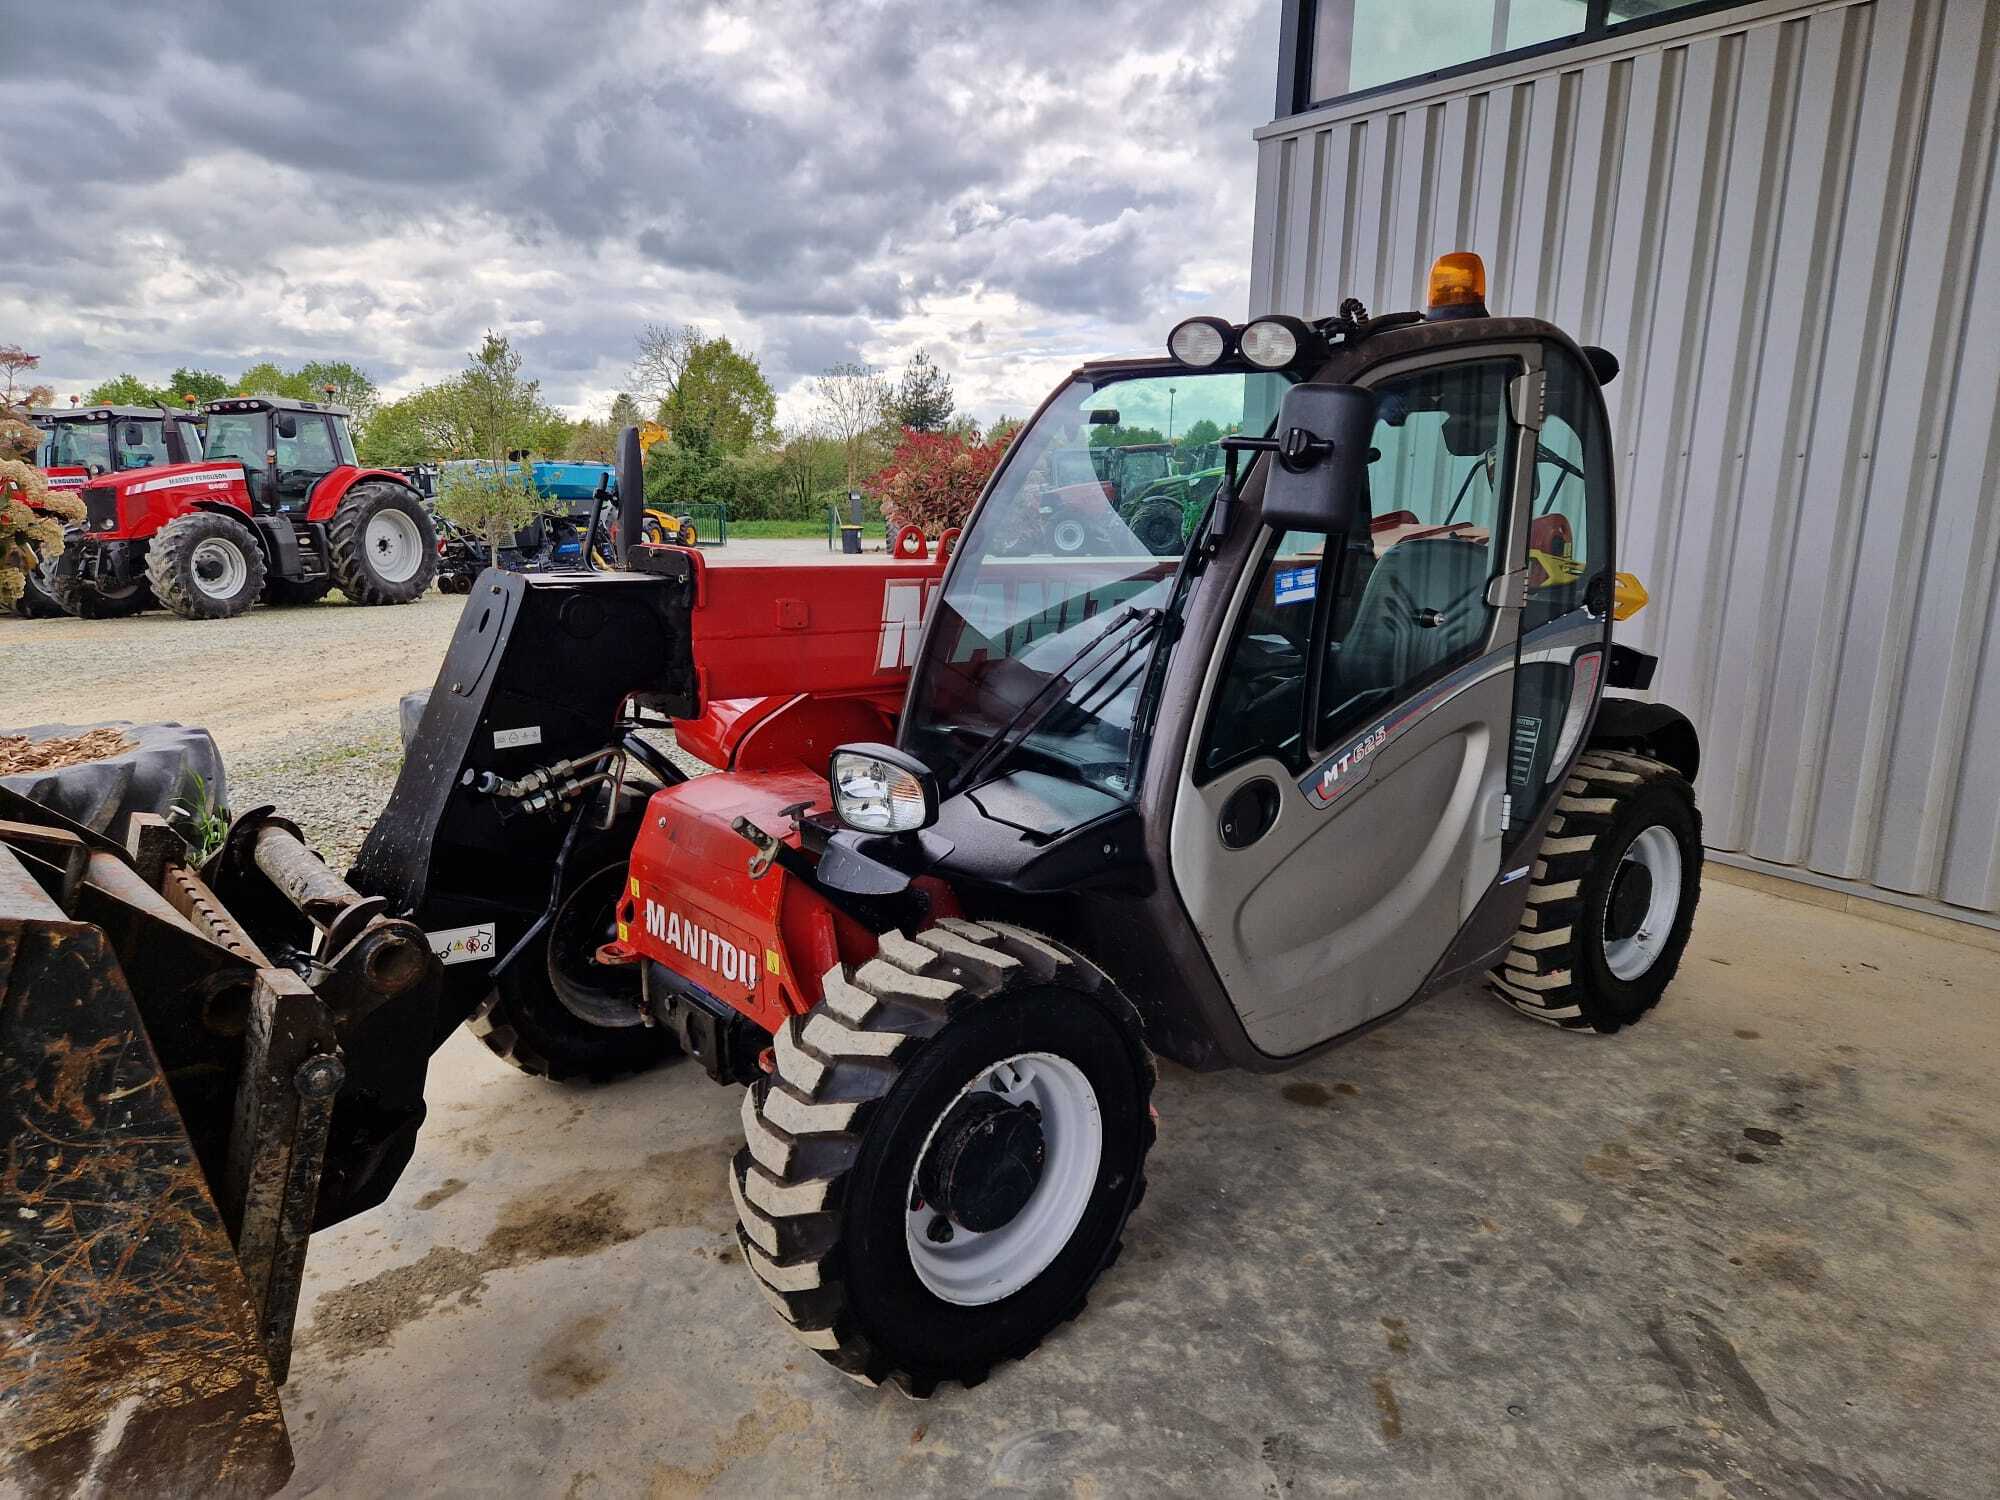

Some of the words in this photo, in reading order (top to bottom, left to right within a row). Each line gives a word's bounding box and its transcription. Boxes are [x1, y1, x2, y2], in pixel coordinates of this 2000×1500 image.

[168, 475, 194, 486] MASSEY
[195, 472, 228, 482] FERGUSON
[1323, 753, 1352, 788] MT
[1353, 725, 1386, 764] 625
[646, 899, 757, 991] MANITOU
